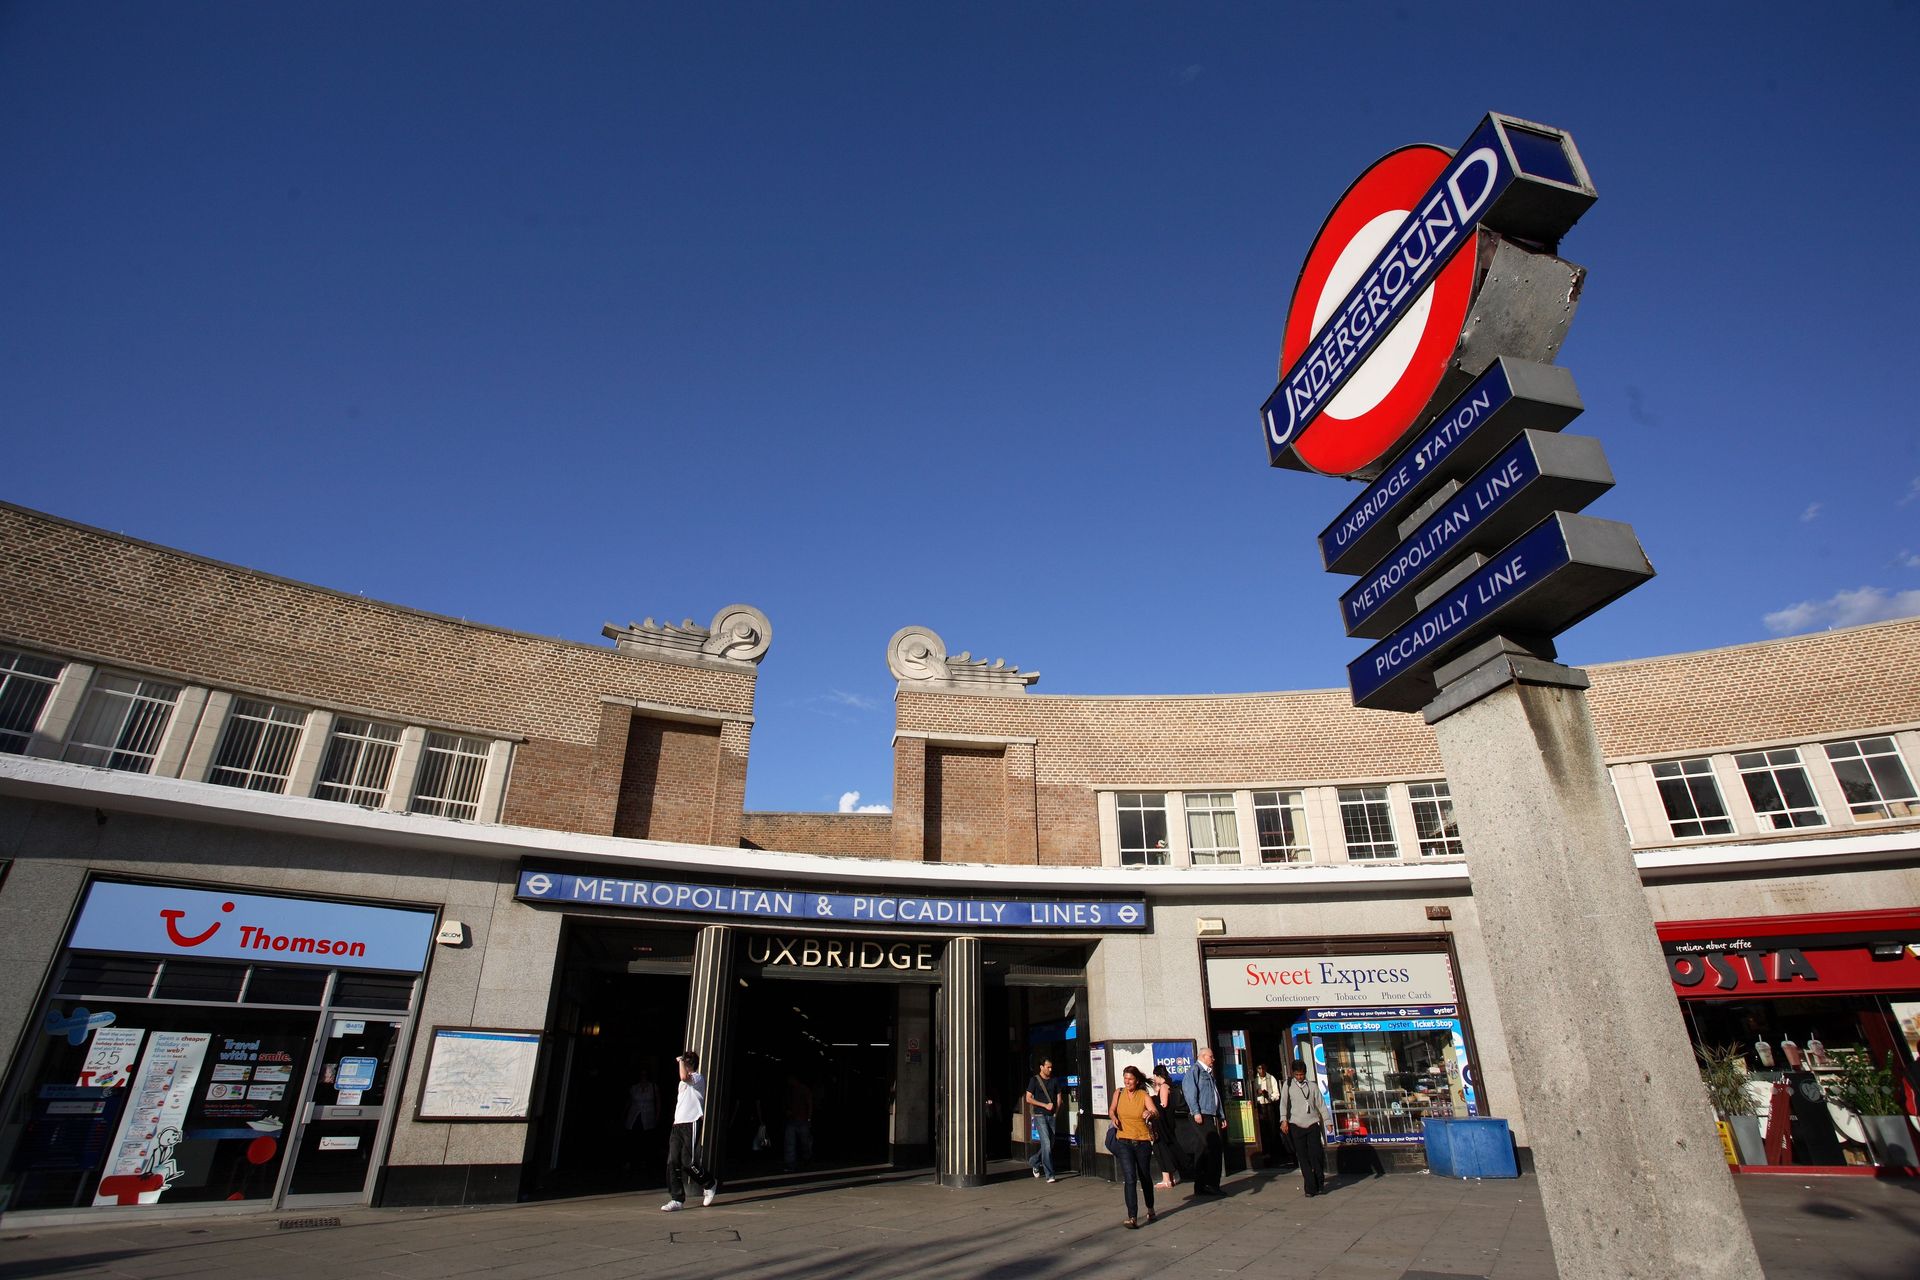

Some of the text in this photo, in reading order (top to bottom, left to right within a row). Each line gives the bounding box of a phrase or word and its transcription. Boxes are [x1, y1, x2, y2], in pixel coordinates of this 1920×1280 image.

[1267, 147, 1499, 445] UNDERGROUND
[1336, 390, 1491, 545] UXBRIDGE STATION
[1352, 459, 1523, 617] METROPOLITAN LINE
[1376, 555, 1527, 676] PICCADILLY LINE
[573, 878, 1101, 924] METROPOLITAN & PICCADILLY LINES
[240, 925, 366, 957] Thomson
[1706, 940, 1728, 950] about
[1729, 939, 1752, 950] coffee
[748, 936, 932, 970] UXBRIDGE
[1246, 962, 1410, 991] Sweet Express
[1666, 948, 1819, 991] OSTA
[1265, 991, 1432, 1004] Confectionery Tobacco Phone Cards
[1317, 1010, 1338, 1019] oyster
[1433, 1007, 1454, 1015] oyster
[1315, 1023, 1338, 1031] oyster
[1339, 1022, 1363, 1030] Ticket
[1363, 1021, 1381, 1031] Stop
[1388, 1021, 1410, 1030] oyster
[1412, 1020, 1435, 1028] Ticket
[1436, 1019, 1453, 1029] Stop
[224, 1039, 260, 1050] Travel
[220, 1050, 248, 1061] with
[258, 1051, 292, 1062] smile.
[1157, 1057, 1176, 1066] HOP
[1165, 1065, 1191, 1074] KE OF
